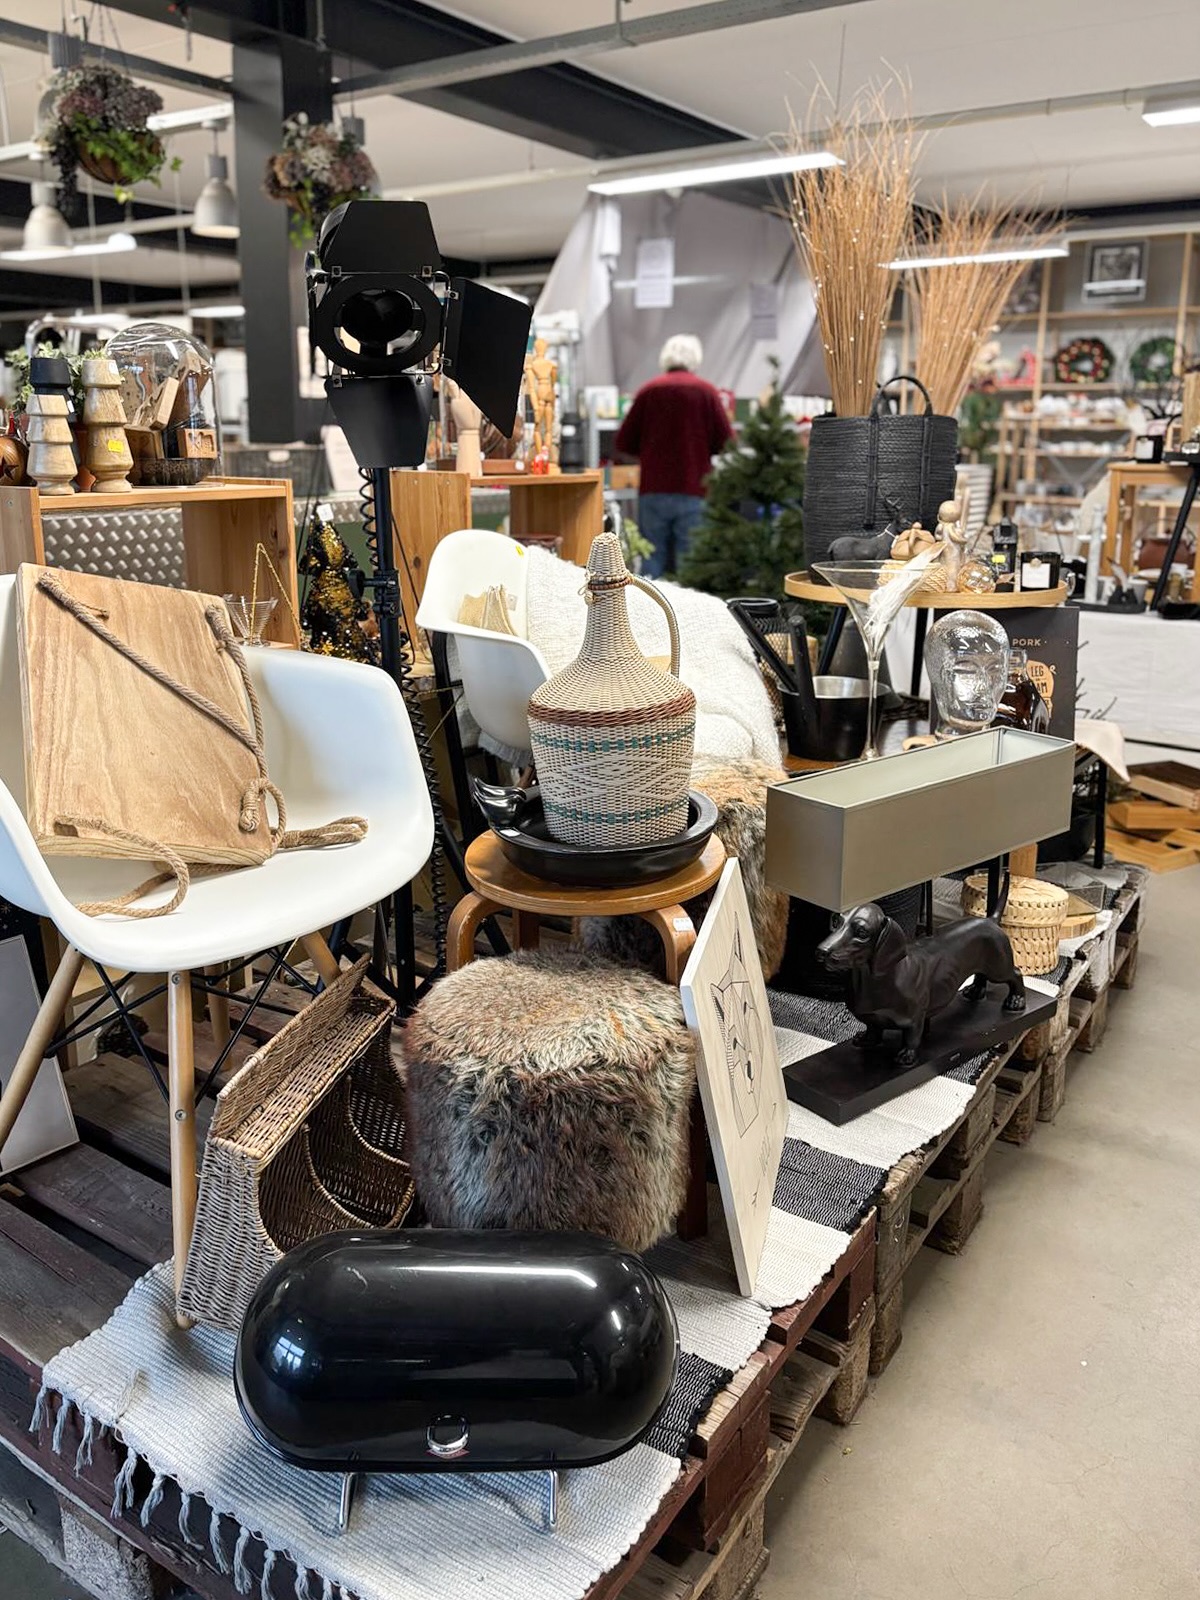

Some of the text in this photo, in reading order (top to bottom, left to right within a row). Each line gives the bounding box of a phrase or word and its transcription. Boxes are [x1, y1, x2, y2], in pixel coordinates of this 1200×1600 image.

[1012, 638, 1041, 646] PORK
[1031, 665, 1044, 677] LEG
[1036, 681, 1048, 694] AM
